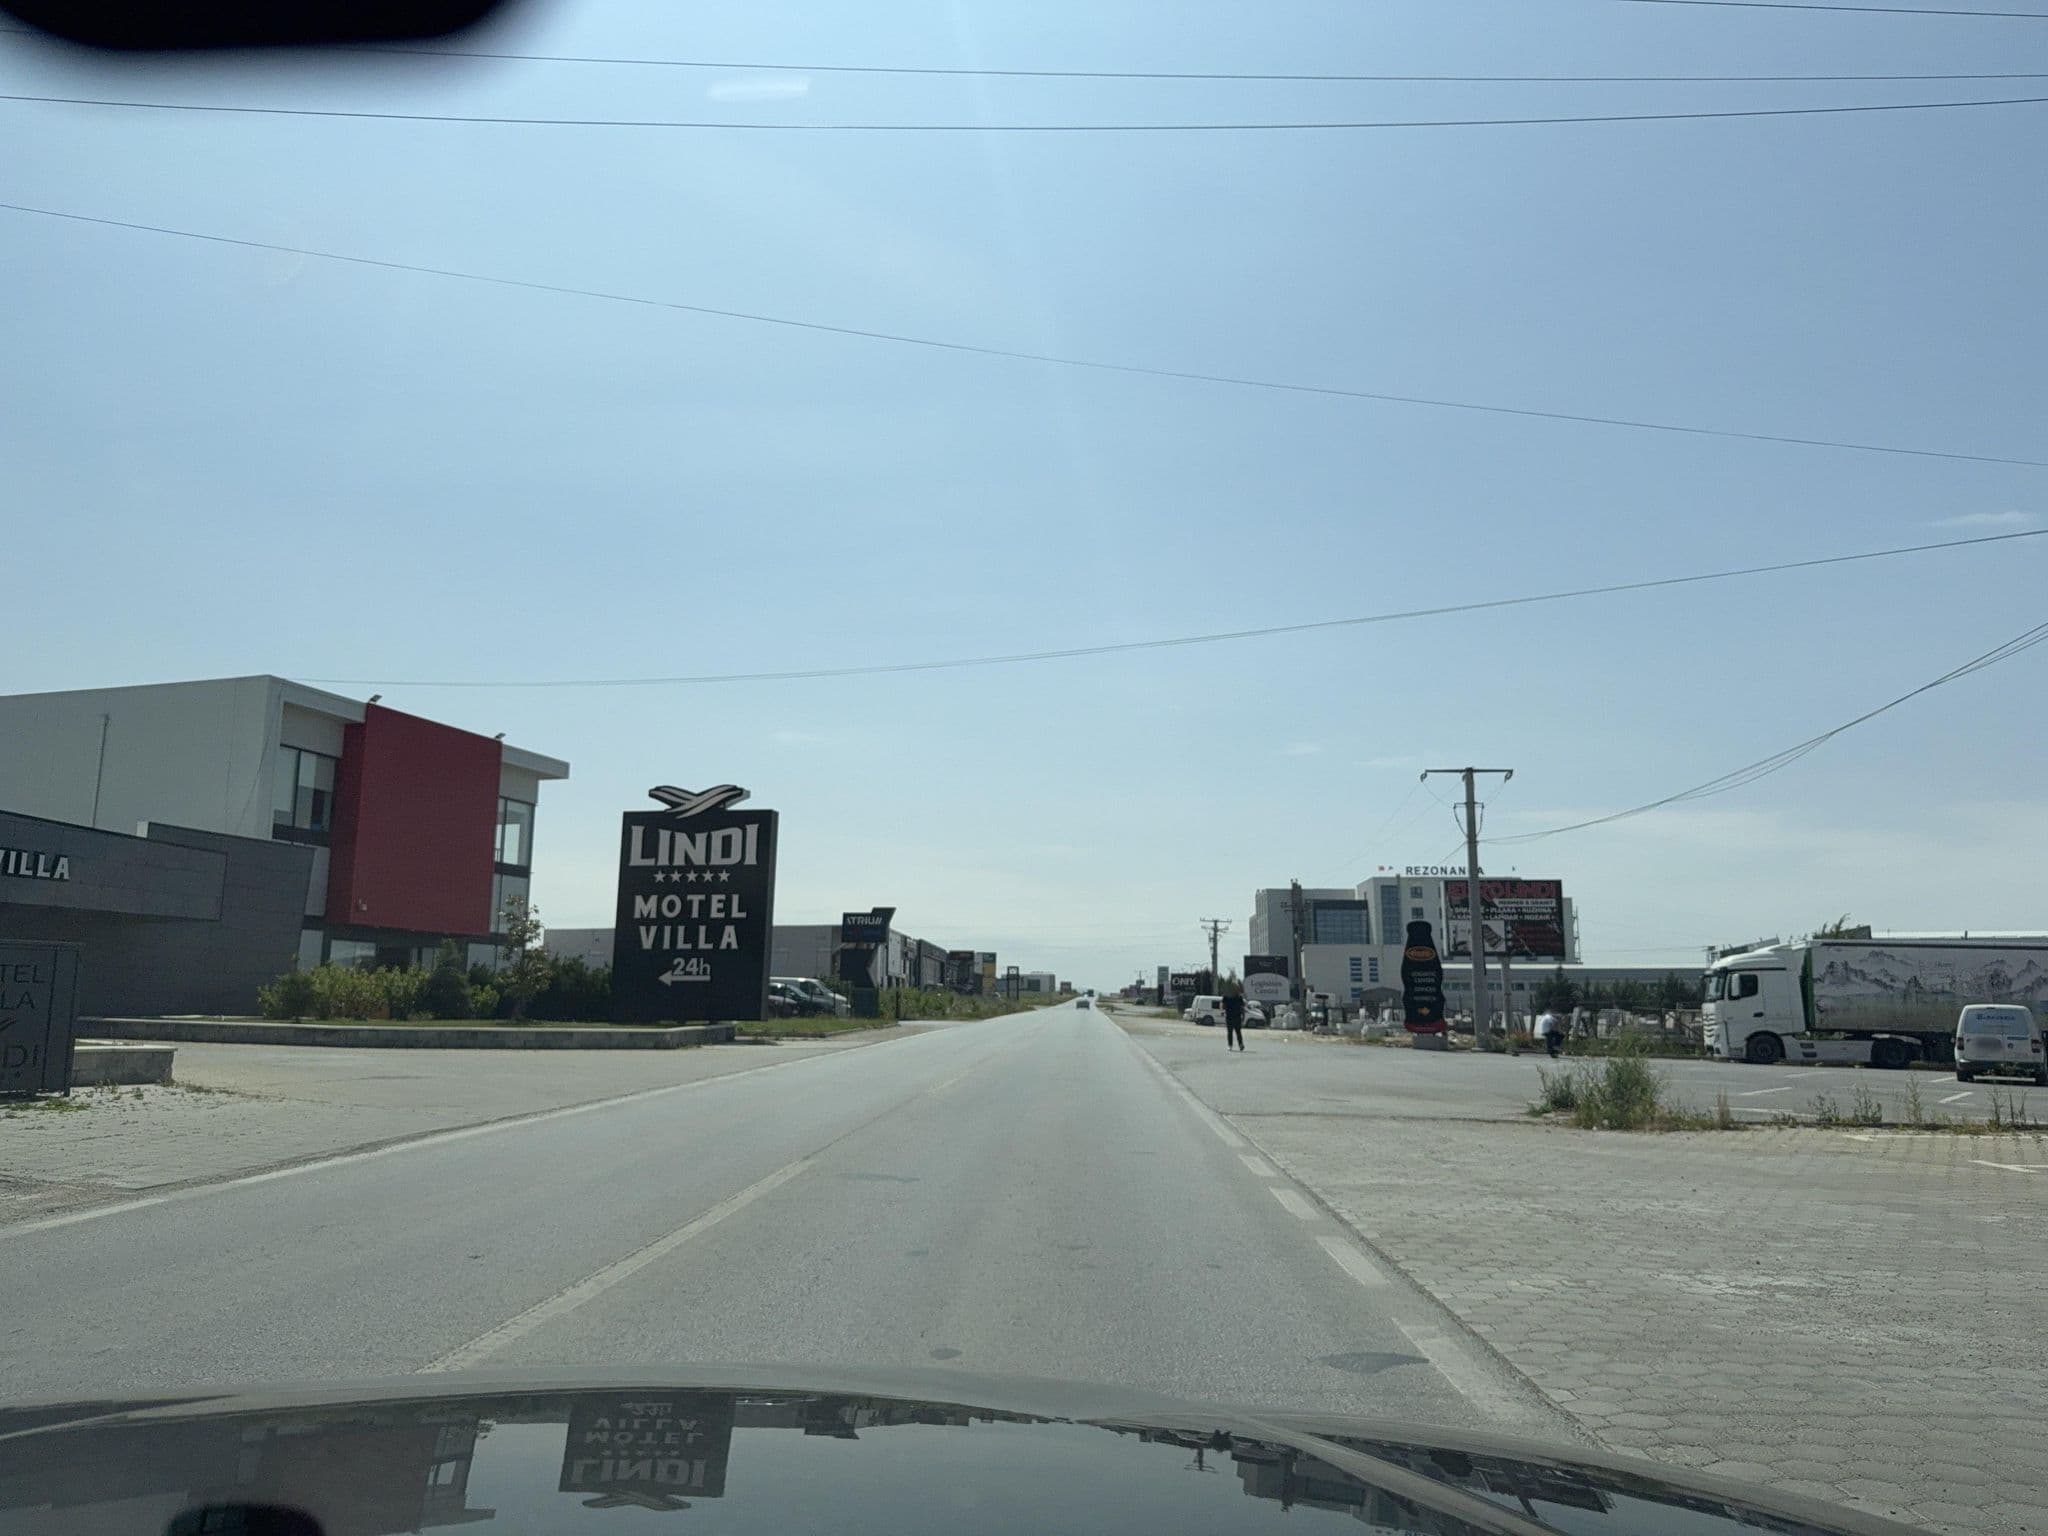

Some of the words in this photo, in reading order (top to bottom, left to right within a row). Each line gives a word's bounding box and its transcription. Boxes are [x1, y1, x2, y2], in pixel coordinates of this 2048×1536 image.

[628, 823, 760, 867] LINDI
[1405, 866, 1484, 876] REZONANA
[633, 893, 747, 919] MOTEL
[639, 924, 738, 950] VILLA
[672, 957, 711, 975] 24h
